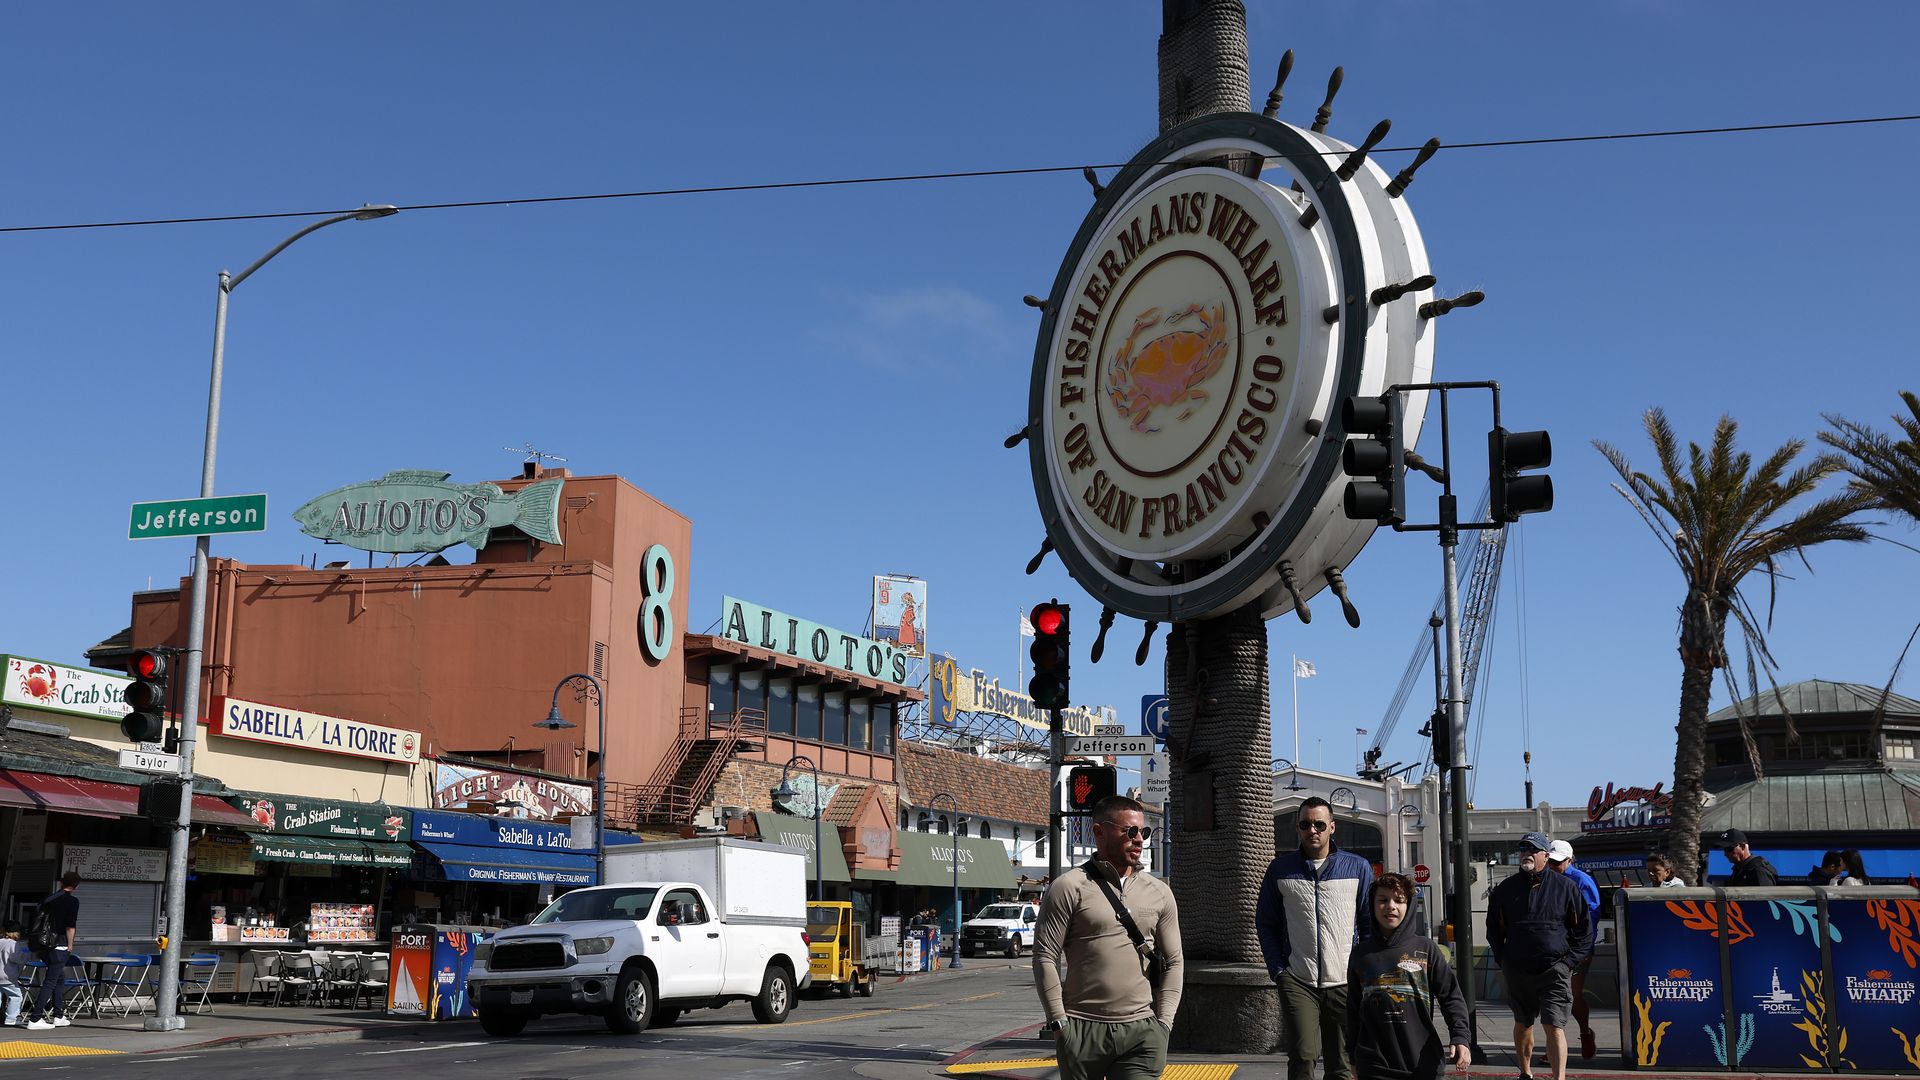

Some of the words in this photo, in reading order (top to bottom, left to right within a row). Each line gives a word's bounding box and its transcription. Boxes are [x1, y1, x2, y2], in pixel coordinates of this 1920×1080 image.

[1060, 191, 1208, 408] FISHERMANS
[1206, 193, 1288, 328] WHARF
[1063, 421, 1098, 475] OF
[1082, 469, 1138, 535] SAN
[1138, 354, 1285, 538] FRANCISCO
[137, 508, 257, 530] Jefferson
[329, 493, 490, 534] ALIOTO'S
[879, 590, 889, 605] 9
[637, 543, 675, 668] 8
[725, 602, 906, 685] ALIOTO'S
[66, 670, 82, 681] The
[61, 683, 99, 705] Crab
[229, 704, 304, 741] SABELLA
[322, 721, 342, 747] LA
[347, 726, 397, 755] TORRE
[1061, 708, 1091, 736] rotto
[1105, 726, 1122, 735] 200
[1073, 740, 1146, 752] Jefferson
[135, 755, 168, 769] Taylor
[437, 774, 501, 809] LIGHT
[285, 803, 297, 811] THE
[284, 812, 307, 830] Crab
[308, 807, 341, 825] Station
[1614, 805, 1653, 828] HUT
[361, 827, 376, 837] Wharf
[498, 826, 534, 846] Sabella
[536, 834, 543, 846] &
[65, 847, 91, 857] ORDER
[265, 847, 281, 857] Fresh
[282, 849, 295, 858] Crab
[299, 850, 314, 859] Clam
[339, 853, 352, 861] Fried
[374, 855, 392, 863] Seafood
[67, 857, 88, 866] HERE
[98, 856, 135, 866] CHOWDER
[1581, 861, 1610, 869] COCKTAILS
[1612, 860, 1628, 868] COLD
[1628, 859, 1643, 868] BEER
[91, 864, 115, 873] BREAD
[117, 865, 142, 875] BOWLS
[469, 867, 498, 880] ORIGINAL
[498, 869, 537, 881] FISHERMAN'S
[537, 871, 555, 882] WHARF
[555, 872, 590, 884] RESTAURANT
[1413, 869, 1429, 879] STOP
[400, 934, 427, 945] PORT
[1647, 975, 1713, 987] Fisherman's
[1845, 976, 1915, 989] Fisherman's
[1648, 987, 1714, 1002] WHARF
[1846, 988, 1915, 1004] WHARF
[392, 1001, 424, 1011] SAILING
[1763, 1003, 1792, 1012] PORT
